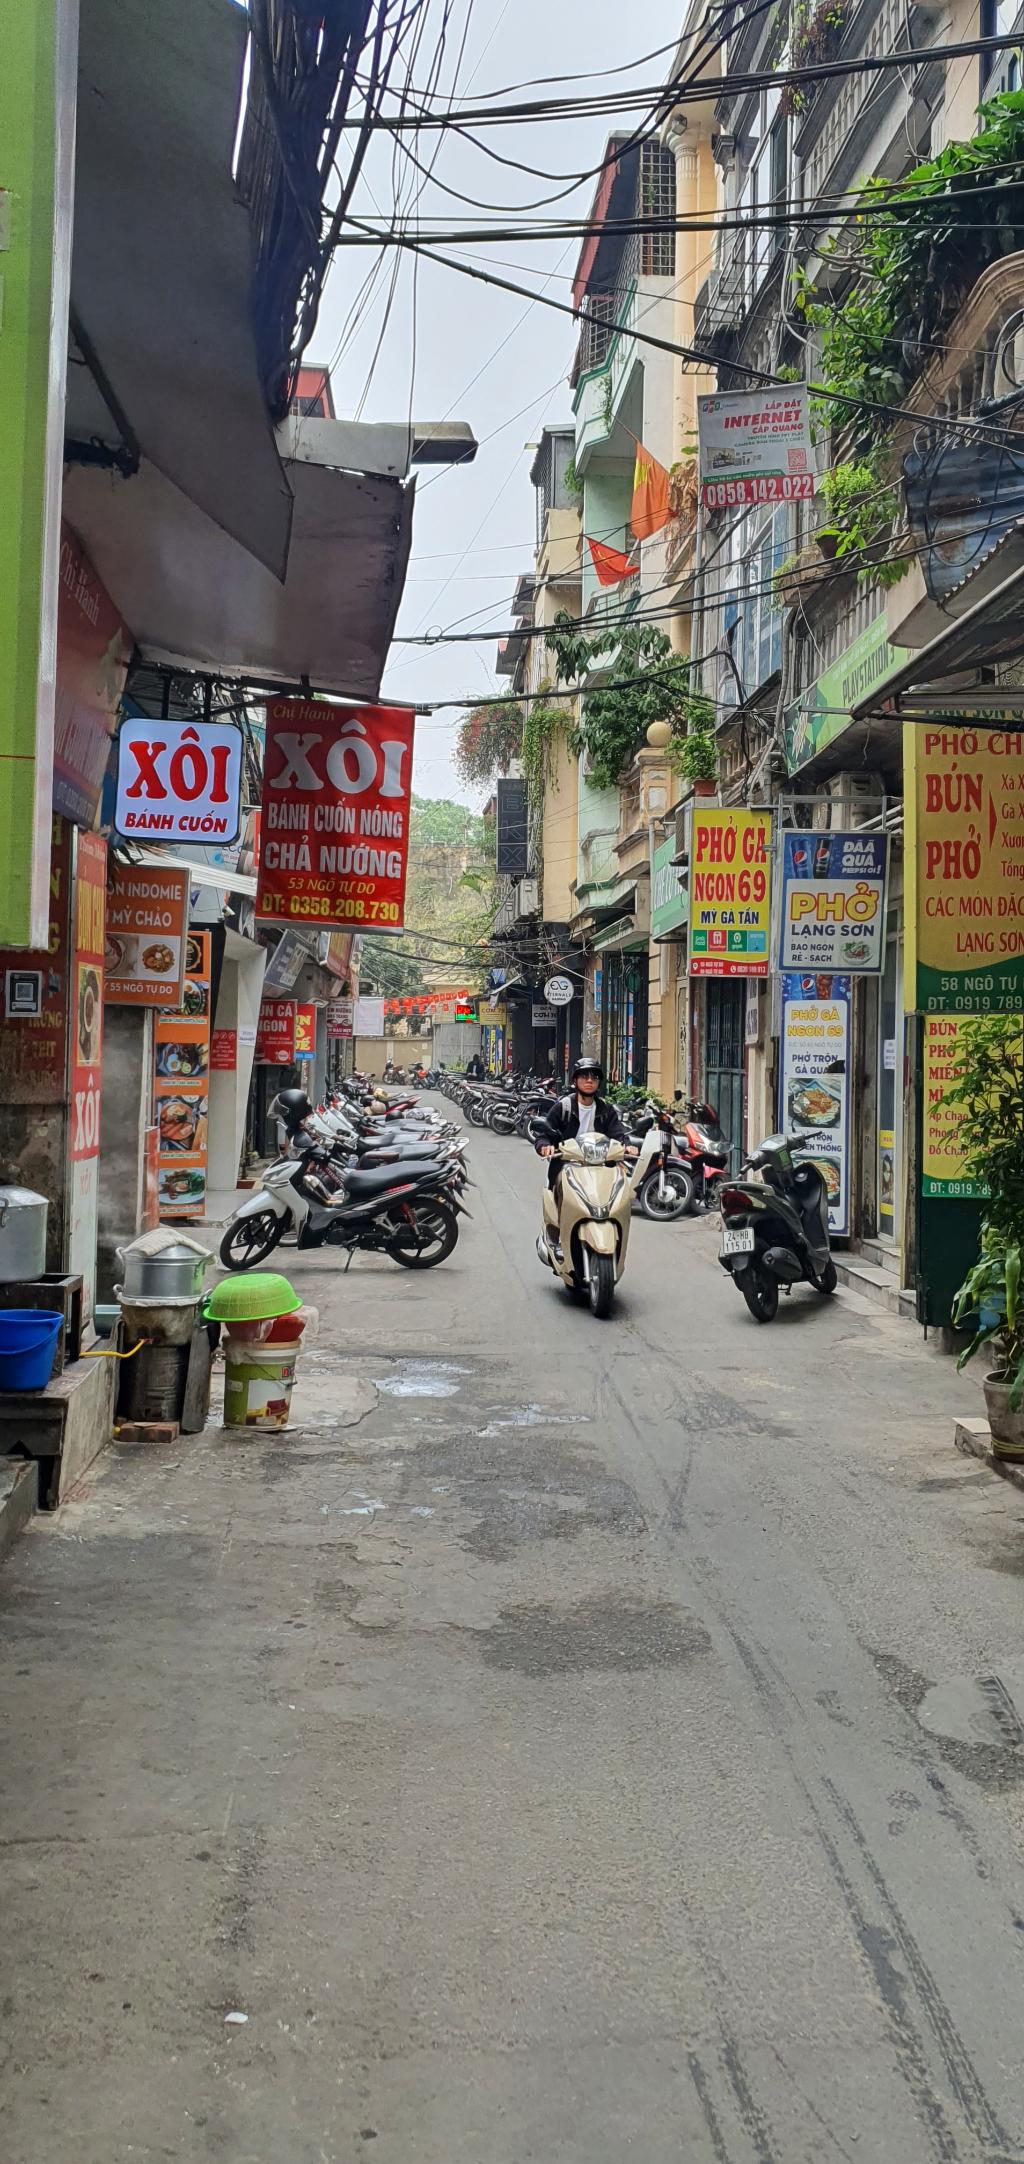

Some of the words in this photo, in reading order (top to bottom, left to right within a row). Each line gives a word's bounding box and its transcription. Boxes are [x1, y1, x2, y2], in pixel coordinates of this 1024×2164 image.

[724, 410, 802, 429] INTERNET
[752, 425, 770, 434] CÁP
[771, 423, 804, 433] QUANG
[707, 476, 812, 506] 0858.142.022
[842, 640, 889, 707] PLAYSTATION
[272, 705, 295, 720] Chị
[300, 707, 335, 722] Hạnh
[925, 727, 978, 755] PHỞ
[125, 726, 231, 803] XÔI
[269, 718, 408, 798] XÔI
[925, 762, 983, 813] BÚN
[125, 808, 174, 830] BÁNH
[178, 810, 227, 833] CUỐN
[267, 798, 310, 831] BÁNH
[314, 798, 356, 835] CUỐN
[360, 803, 403, 839] NÓNG
[696, 815, 738, 864] PHỞ
[742, 818, 767, 864] GÀ
[264, 835, 312, 873] CHẢ
[319, 842, 402, 879] NƯỚNG
[925, 823, 981, 880] PHỞ
[127, 883, 182, 900] INDOMIE
[287, 877, 304, 890] 53
[307, 877, 335, 893] NGÕ
[338, 879, 355, 896] TỰ
[357, 881, 376, 895] DO
[694, 872, 736, 902] NGON
[738, 869, 767, 903] 69
[262, 893, 286, 914] ĐT:
[290, 897, 399, 921] 0358.208.730
[790, 881, 880, 922] PHỞ
[925, 890, 955, 917] CÁC
[958, 890, 993, 917] MÓN
[135, 906, 172, 927] CHẢO
[721, 907, 735, 924] GÀ
[791, 924, 836, 939] LẠNG
[840, 923, 874, 937] SƠN
[790, 943, 808, 951] BAO
[810, 943, 834, 951] NGON
[956, 932, 995, 958] LẠNG
[809, 954, 832, 964] SẠCH
[123, 983, 144, 993] NGÕ
[159, 985, 173, 994] DO
[941, 977, 958, 991] 58
[964, 975, 993, 991] NGÕ
[999, 975, 1018, 993] TỰ
[276, 1002, 293, 1017] CÁ
[928, 996, 950, 1010] ĐT:
[955, 996, 991, 1010] 0919
[996, 995, 1023, 1010] 789
[791, 1004, 818, 1021] PHỞ
[821, 1004, 840, 1021] GÀ
[787, 1025, 824, 1037] NGON
[827, 1025, 844, 1037] 69
[928, 1019, 957, 1036] BÚN
[791, 1051, 811, 1063] PHỞ
[813, 1052, 839, 1065] TRỘN
[795, 1063, 808, 1075] GÀ
[809, 1065, 830, 1075] QUA
[74, 1072, 101, 1152] XÔI
[816, 1140, 842, 1153] THỐNG
[930, 1182, 945, 1194] ĐT:
[948, 1183, 972, 1195] 0919
